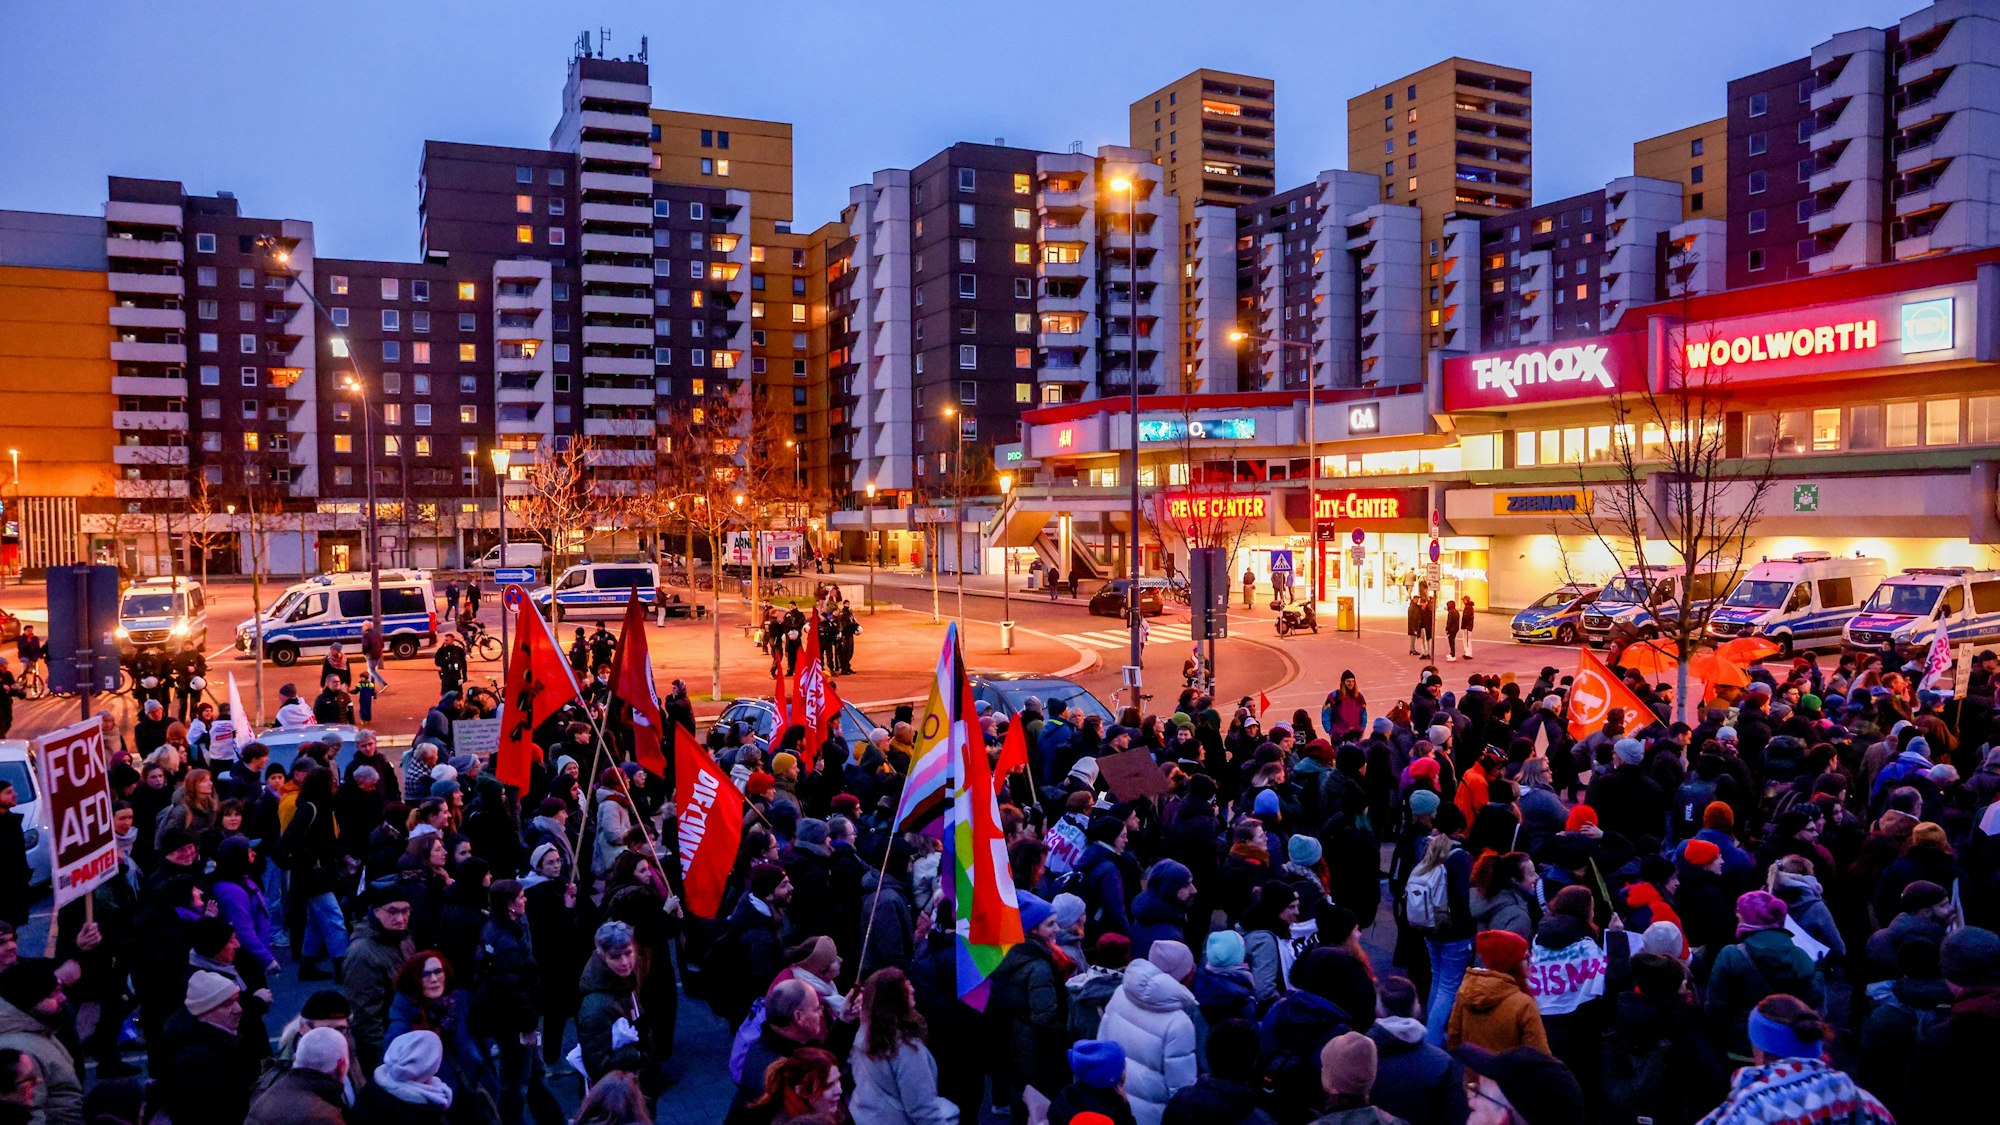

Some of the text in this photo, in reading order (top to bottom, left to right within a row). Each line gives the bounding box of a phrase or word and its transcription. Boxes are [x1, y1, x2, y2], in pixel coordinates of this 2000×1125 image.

[1686, 320, 1877, 369] WOOLWORTH
[1507, 495, 1576, 511] ZEEMAN
[47, 734, 104, 794] FCK
[58, 789, 110, 856] AFD
[70, 848, 115, 888] PARTEI
